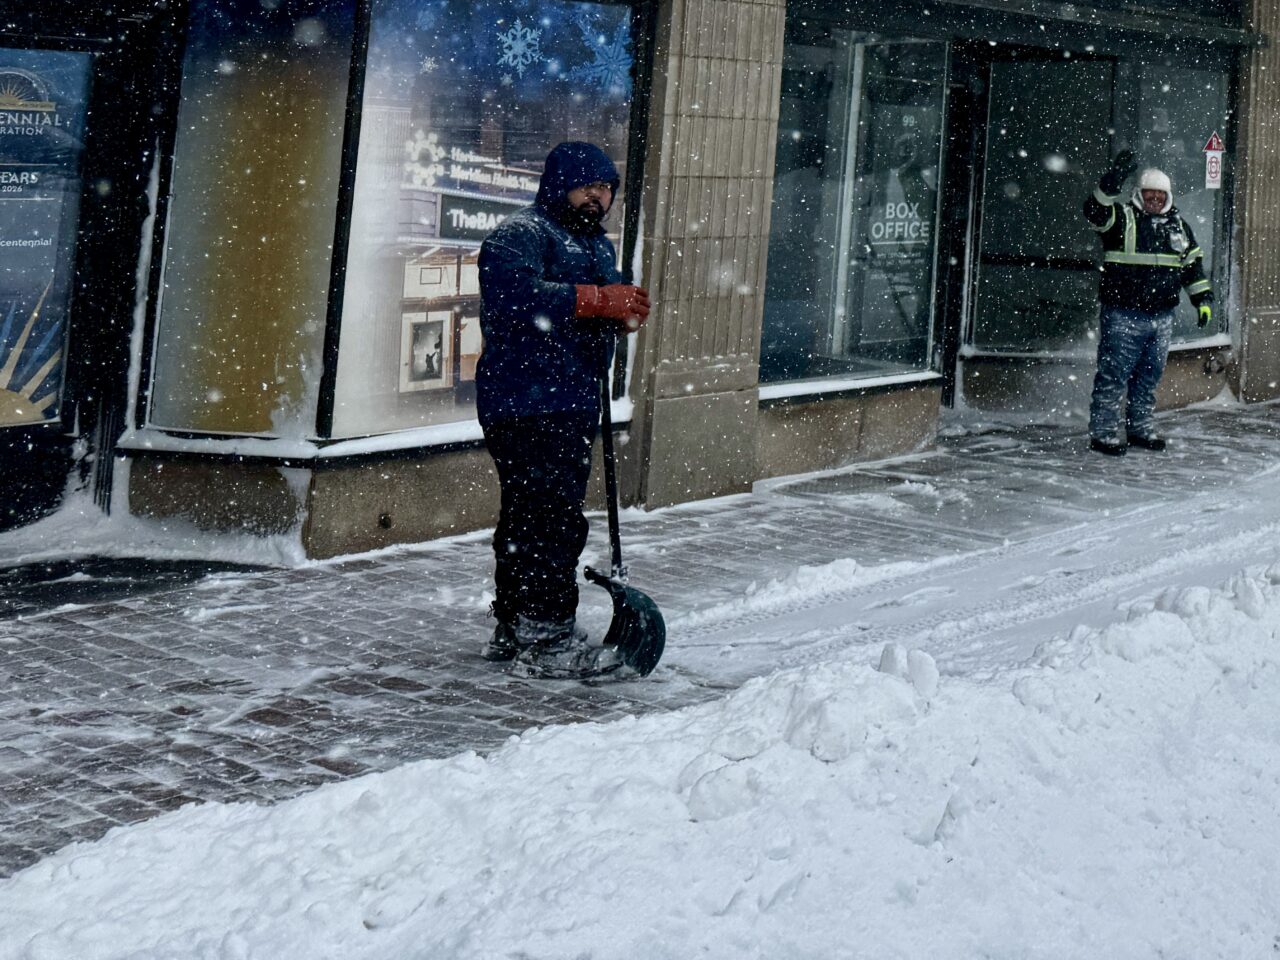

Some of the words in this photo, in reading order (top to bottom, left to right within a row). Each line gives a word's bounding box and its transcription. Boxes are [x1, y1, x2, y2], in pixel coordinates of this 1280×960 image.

[902, 115, 915, 127] 99
[0, 171, 38, 184] EARS
[885, 202, 920, 219] BOX
[872, 221, 930, 238] OFFICE
